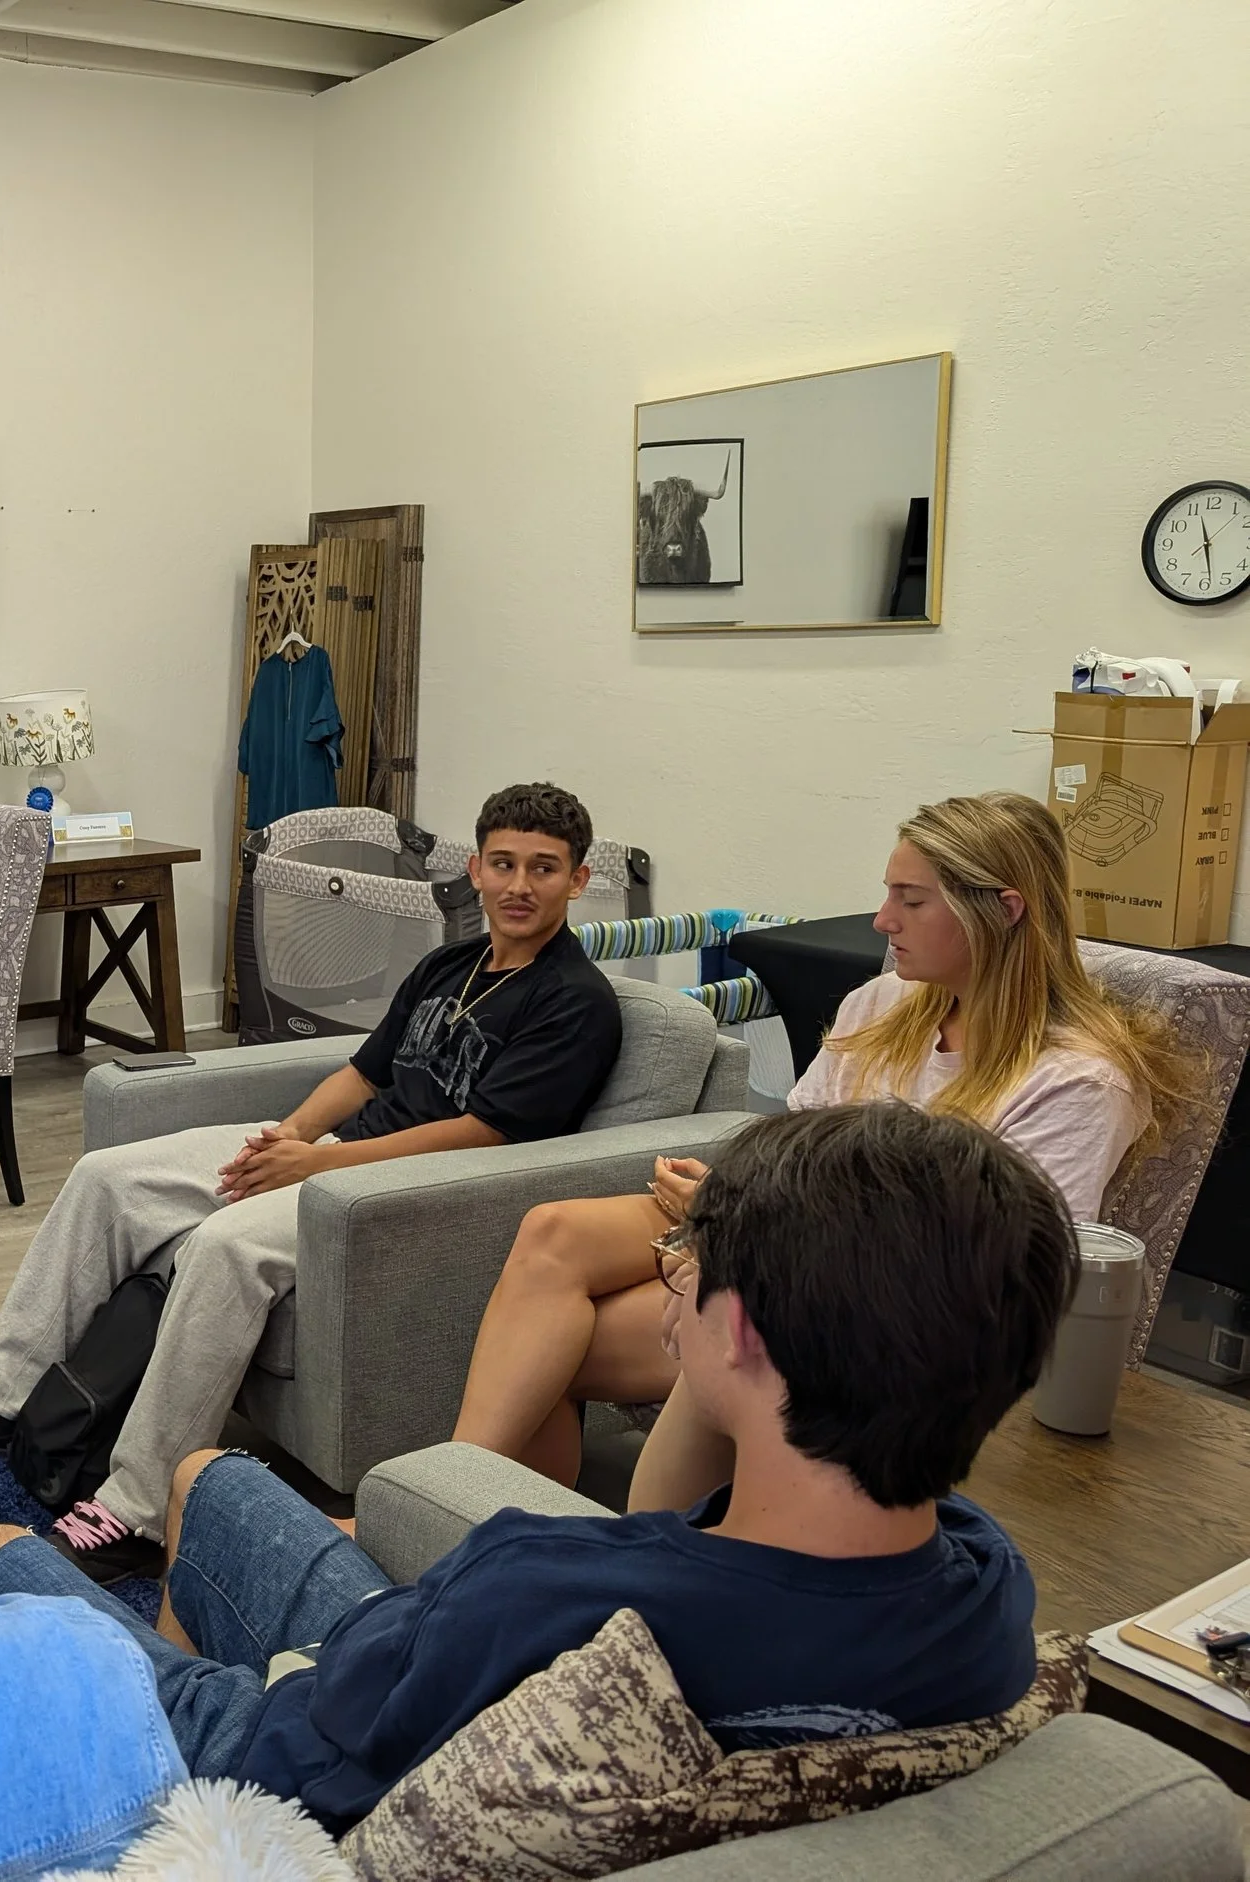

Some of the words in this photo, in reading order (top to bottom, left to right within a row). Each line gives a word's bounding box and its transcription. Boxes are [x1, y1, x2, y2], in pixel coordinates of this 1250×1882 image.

[1187, 503, 1199, 516] 11
[1206, 496, 1222, 510] 12
[1232, 502, 1238, 515] 1
[1170, 519, 1187, 533] 10
[1161, 538, 1174, 551] 9
[1166, 558, 1178, 571] 8
[1236, 557, 1248, 571] 4
[1181, 572, 1192, 585] 7
[1199, 577, 1211, 591] 6
[1219, 572, 1232, 586] 5
[1201, 805, 1219, 816] PINK
[1198, 830, 1217, 841] BLUE
[1195, 855, 1215, 866] GRAY
[1085, 890, 1126, 904] Foldable
[1128, 896, 1163, 909] NAPEI
